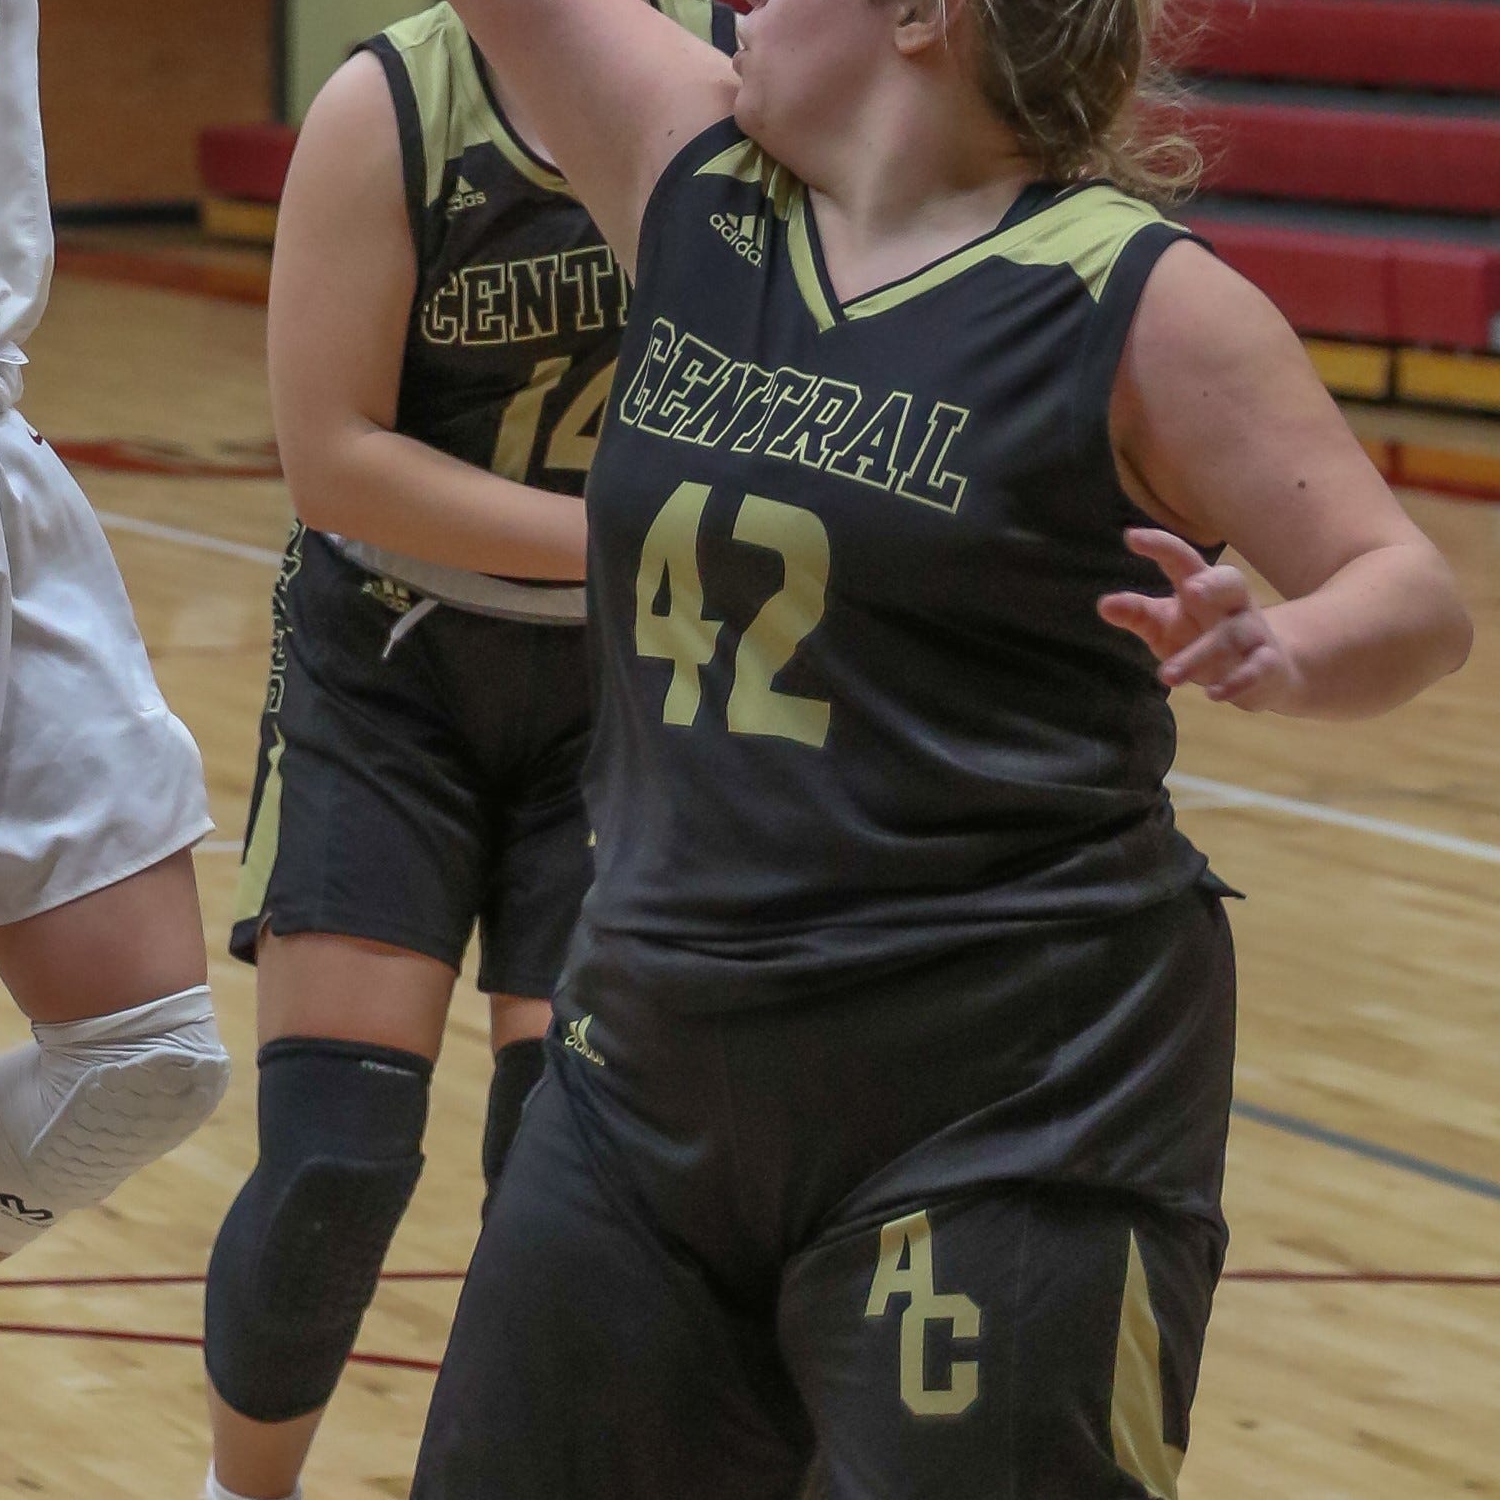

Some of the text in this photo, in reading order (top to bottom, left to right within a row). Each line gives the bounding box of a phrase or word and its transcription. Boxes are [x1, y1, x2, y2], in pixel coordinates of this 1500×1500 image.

[423, 245, 629, 345] CENT
[709, 213, 762, 268] adida
[617, 316, 972, 515] CENTRAL
[635, 481, 832, 748] 42
[864, 1209, 982, 1417] AC
